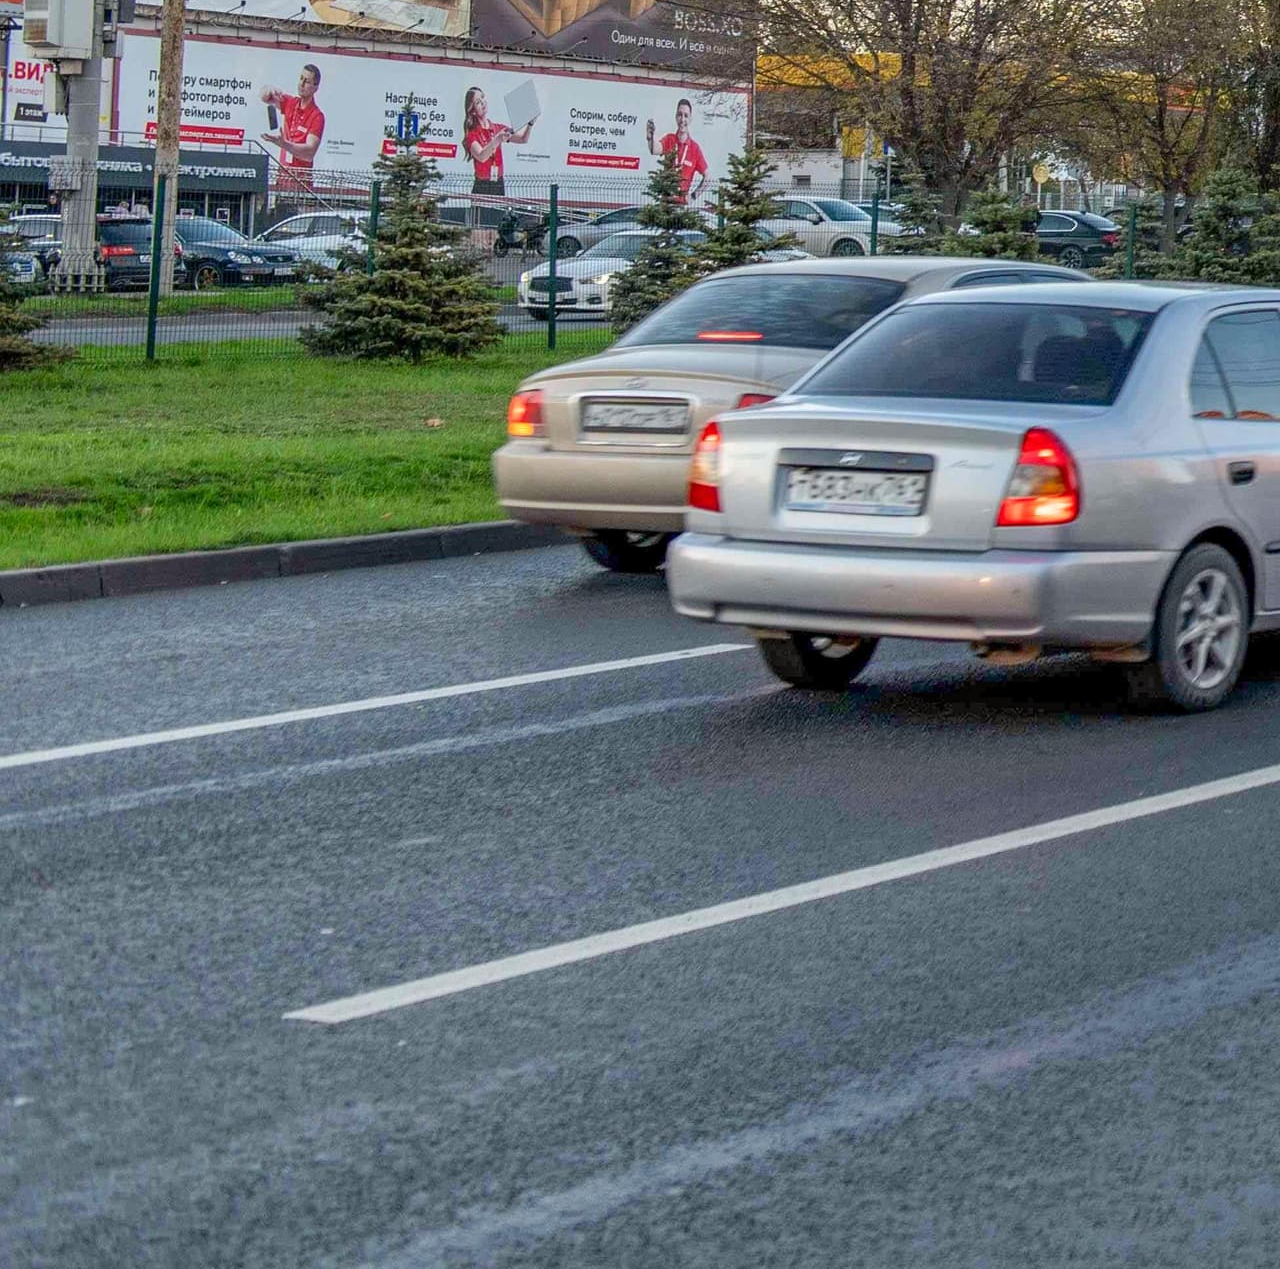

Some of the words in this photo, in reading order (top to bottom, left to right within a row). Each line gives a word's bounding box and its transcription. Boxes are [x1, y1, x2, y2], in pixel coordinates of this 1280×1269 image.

[611, 30, 636, 46] Один
[638, 35, 654, 47] для
[680, 38, 687, 50] И
[199, 75, 252, 90] смартфон
[181, 90, 247, 106] фотографов,
[429, 109, 446, 122] без
[569, 108, 606, 122] Спорим,
[607, 112, 637, 125] соберу
[569, 124, 607, 136] быстрее,
[609, 128, 625, 136] чем
[569, 138, 580, 147] вы
[581, 140, 617, 151] дойдете
